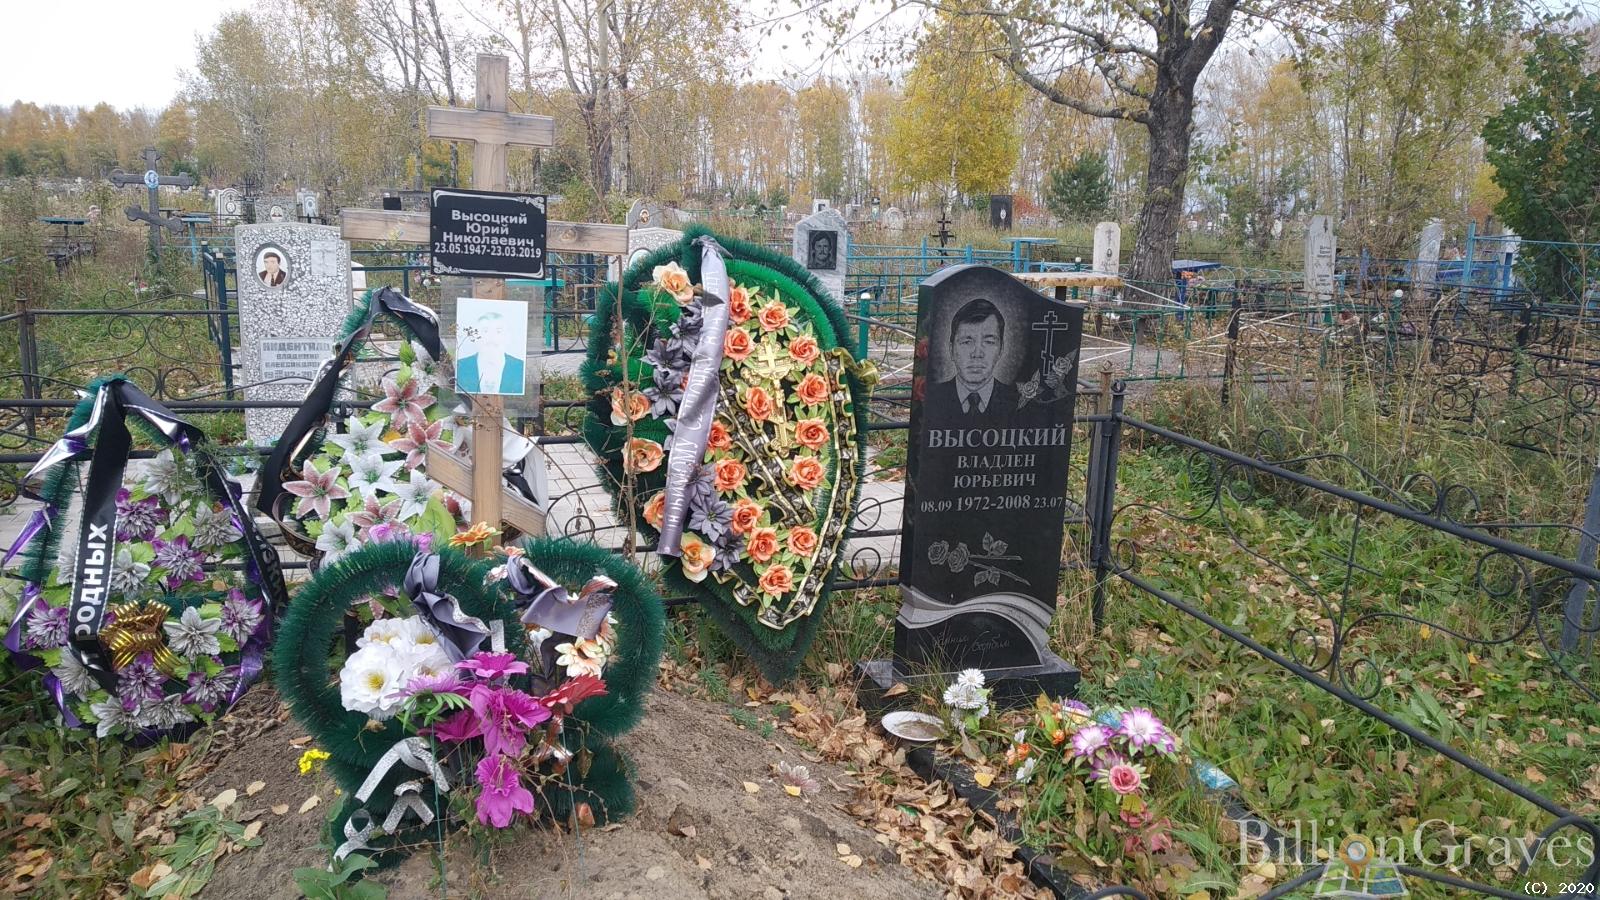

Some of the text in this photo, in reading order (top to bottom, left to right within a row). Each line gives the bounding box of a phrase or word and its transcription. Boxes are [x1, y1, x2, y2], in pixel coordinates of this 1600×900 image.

[451, 209, 528, 225] Высоцкий
[466, 222, 509, 237] Юрий
[442, 231, 535, 248] Николаевич
[434, 242, 542, 259] 23.05.1947-23.03.2019
[927, 423, 1067, 451] ВЫСОЦКИЙ
[957, 454, 1036, 471] ВЛАДЛЕН
[953, 473, 1036, 489] ЮРЬЕВИЧ
[920, 494, 1064, 513] 08.09 1972-2008 23.07
[74, 522, 108, 641] РОДНЫХ
